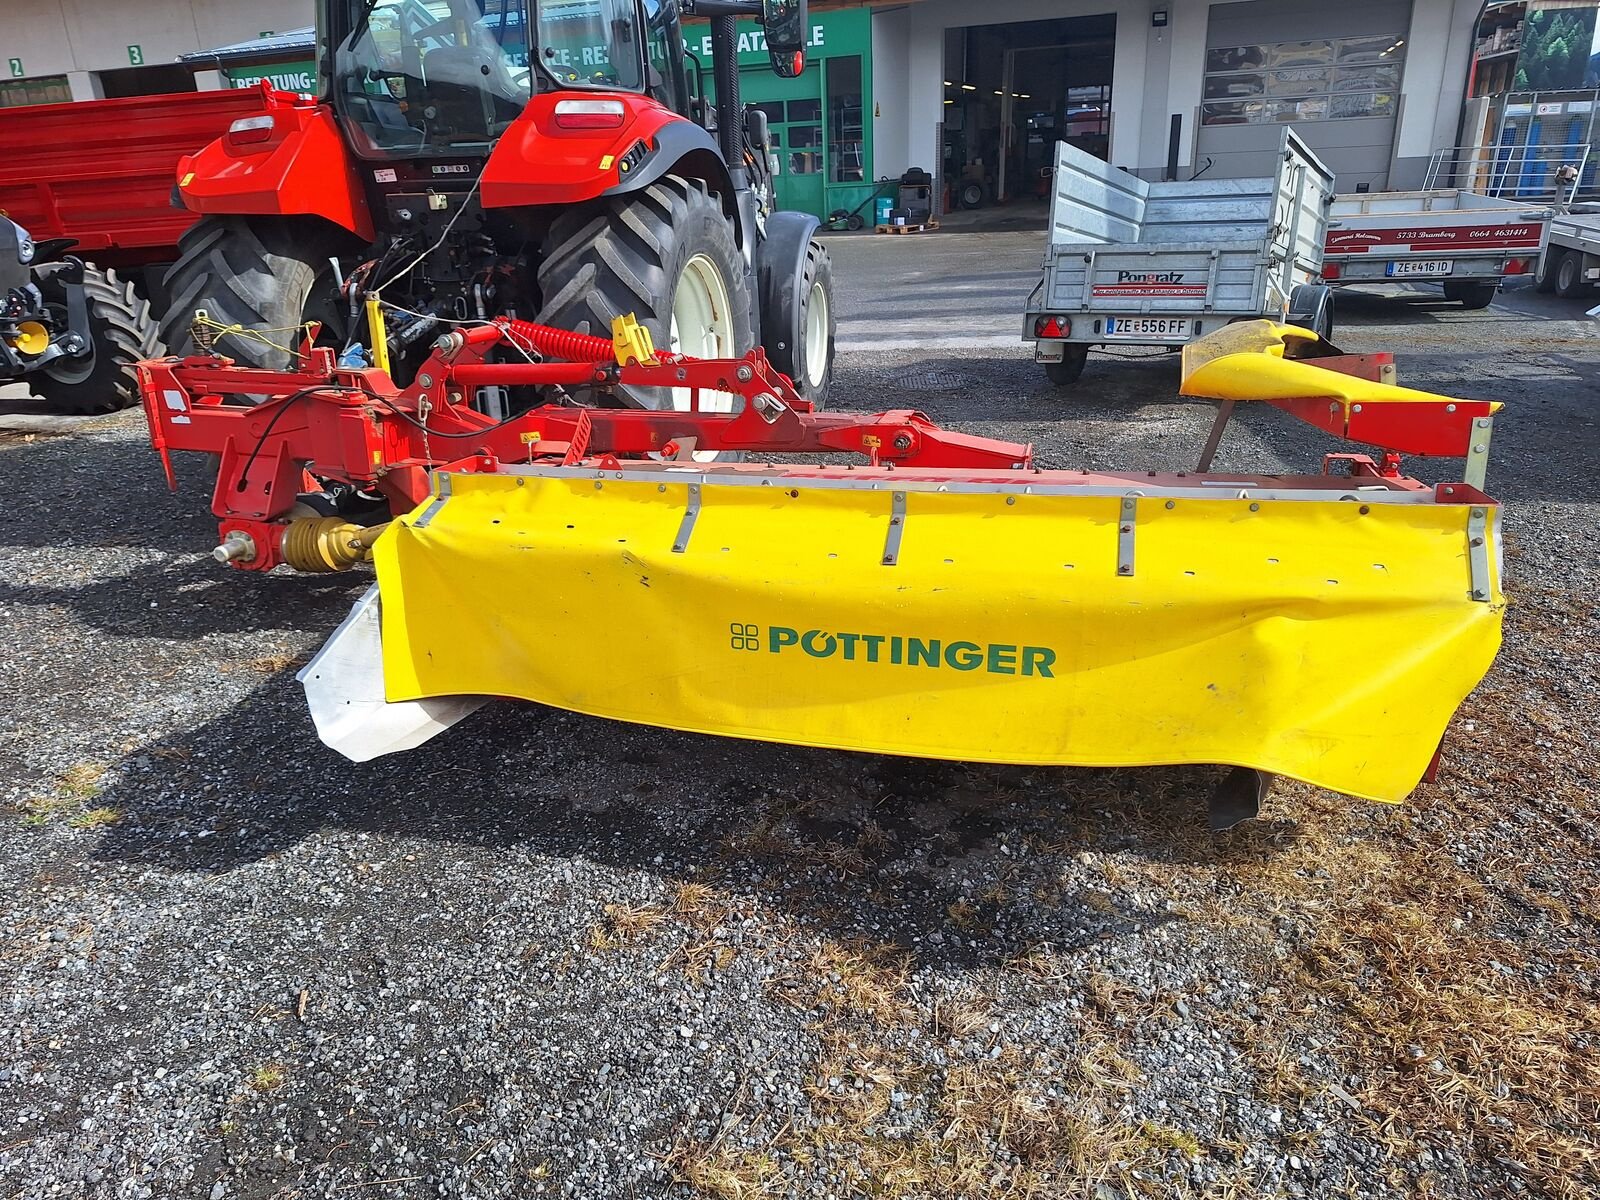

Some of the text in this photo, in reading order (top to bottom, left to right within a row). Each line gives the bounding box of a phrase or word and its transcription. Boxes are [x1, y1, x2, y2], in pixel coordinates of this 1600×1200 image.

[130, 46, 141, 64] 3
[11, 59, 22, 76] 2
[1396, 231, 1417, 240] 5733
[1417, 230, 1457, 240] Bramberg
[1469, 230, 1491, 238] 0664
[1397, 262, 1411, 273] ZE
[1417, 261, 1436, 272] 416
[1117, 270, 1185, 285] Pongratz
[1115, 319, 1133, 334] ZE
[1141, 319, 1167, 334] 556
[1168, 320, 1187, 334] FF
[768, 625, 1058, 679] PÖTTINGER
